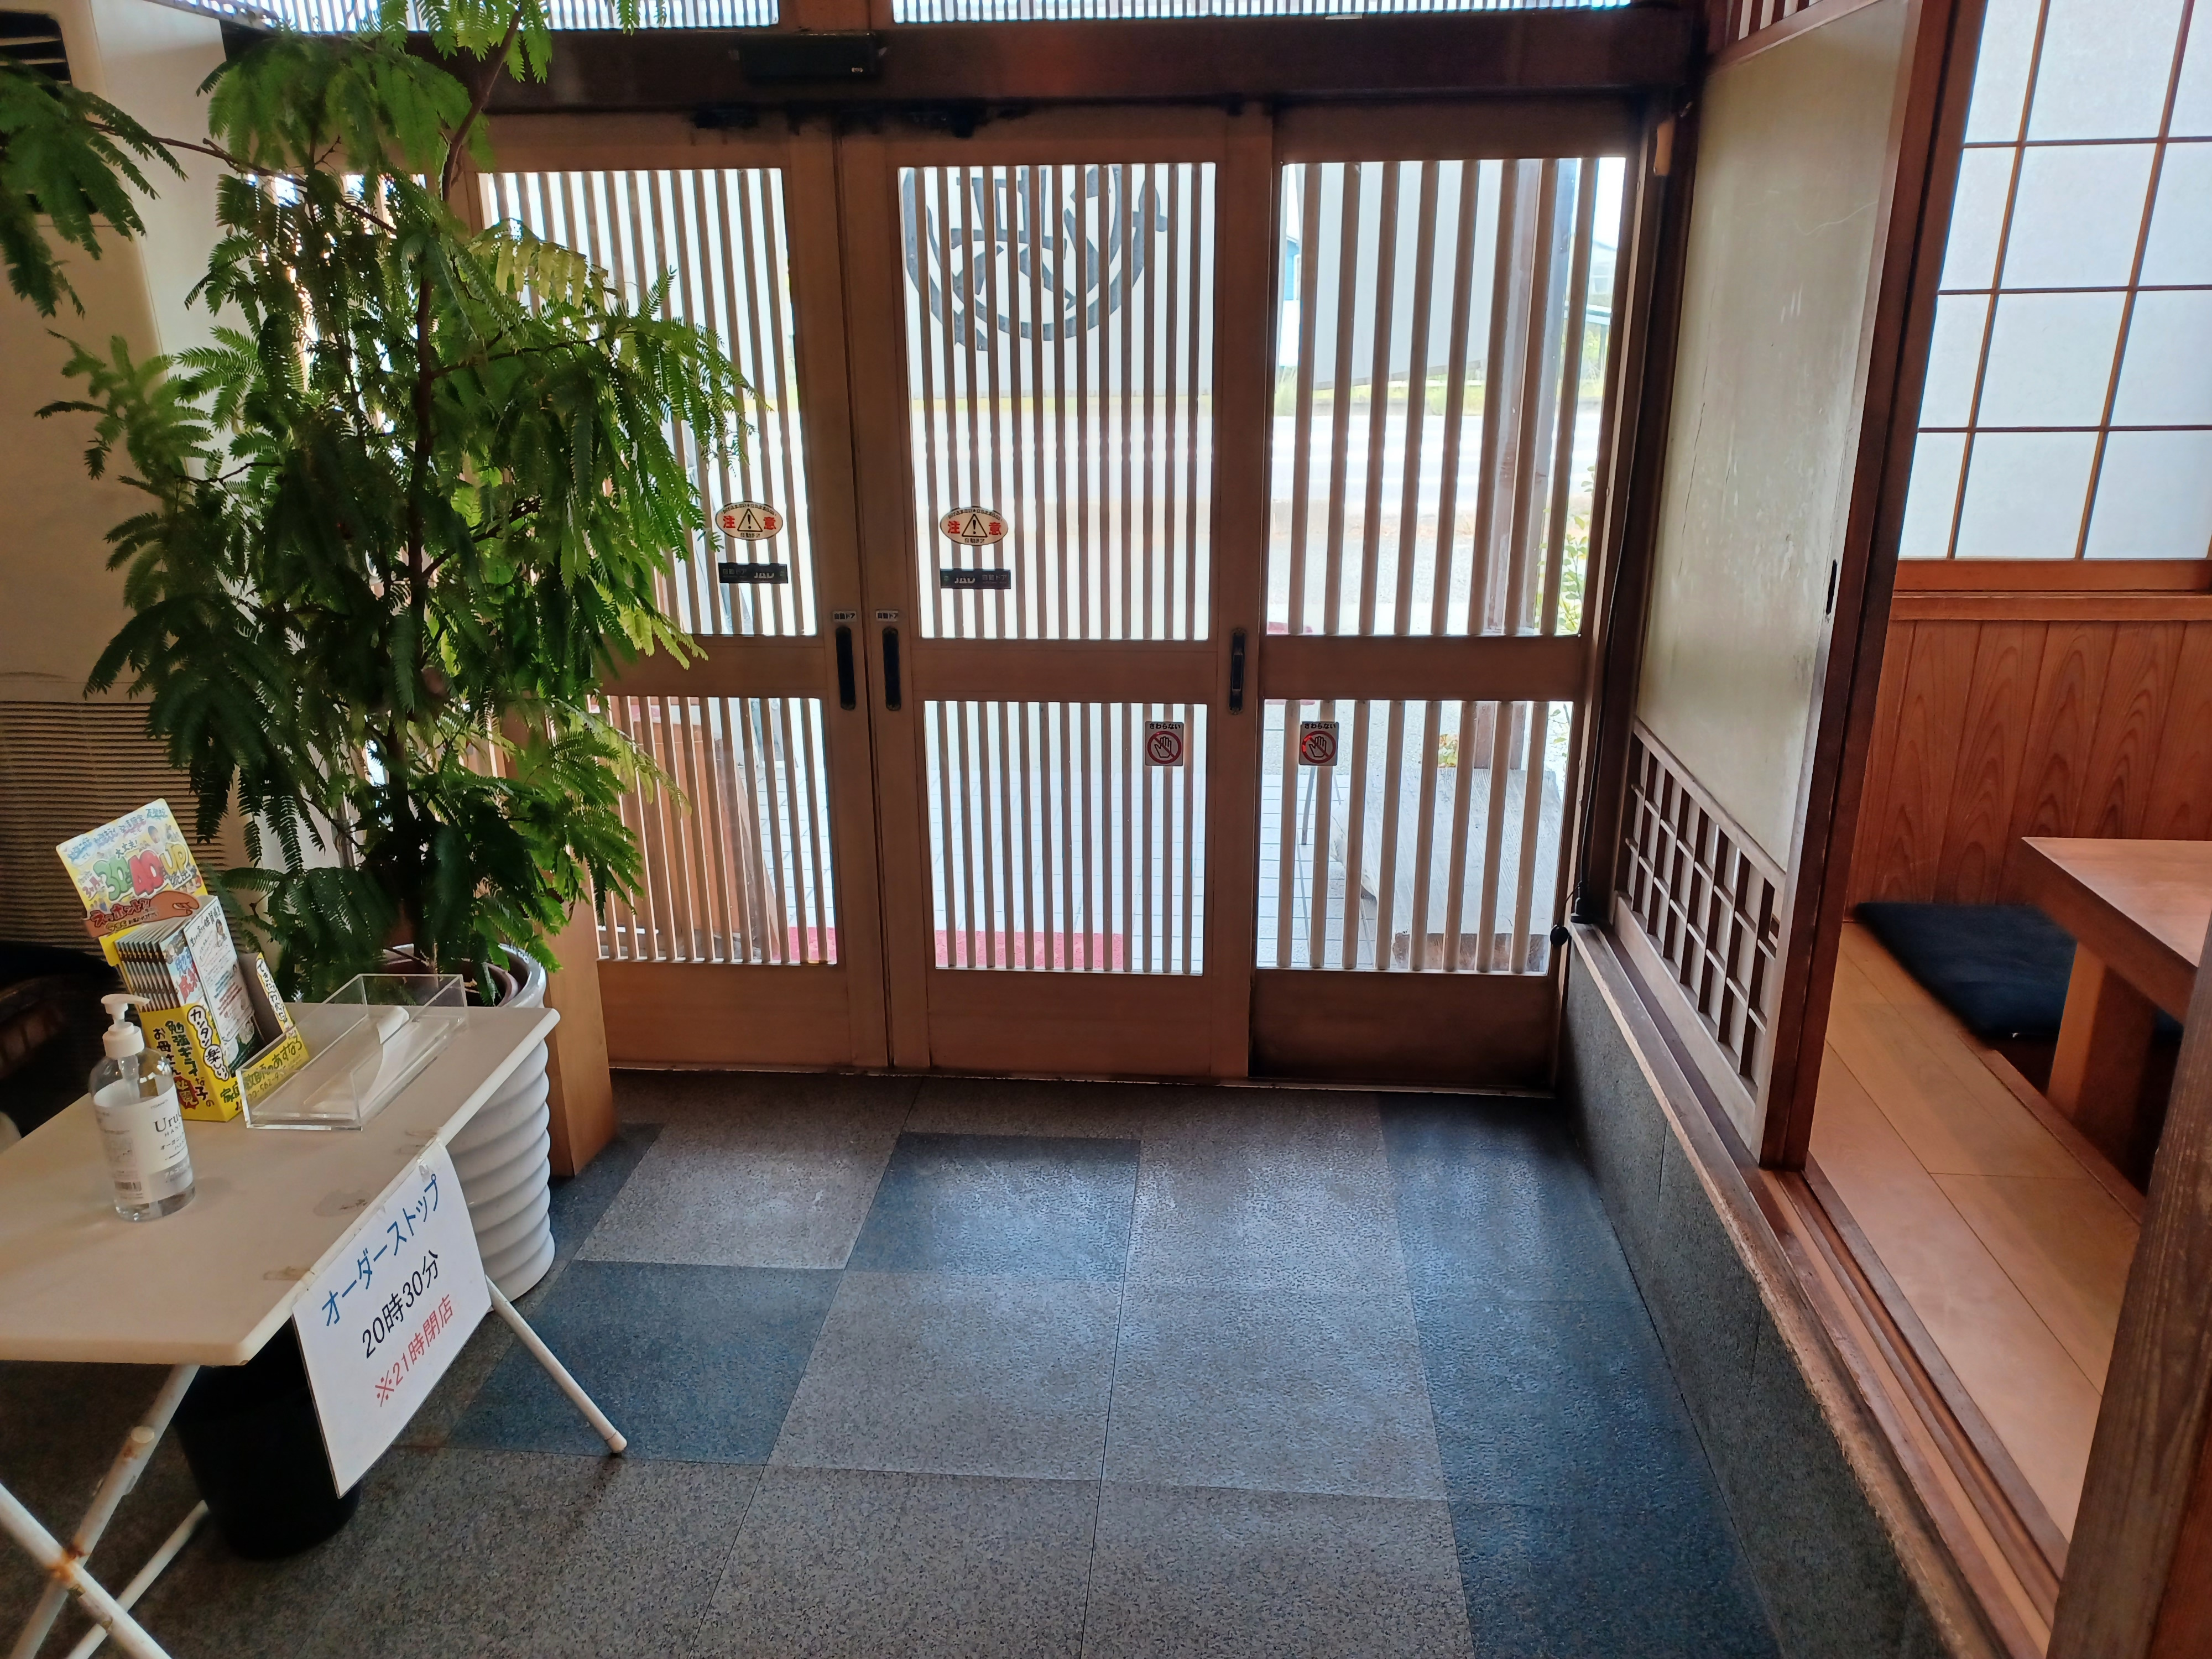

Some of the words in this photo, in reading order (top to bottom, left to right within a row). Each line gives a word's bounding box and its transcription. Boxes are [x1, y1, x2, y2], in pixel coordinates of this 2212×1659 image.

[723, 515, 735, 528] 注
[763, 517, 776, 530] 意
[947, 520, 961, 534] 注
[988, 522, 1002, 535] 意
[190, 1009, 210, 1047] カンタン
[322, 1173, 439, 1327] オーダーストップ
[362, 1249, 439, 1359] 20時30分
[374, 1294, 454, 1408] ※21時閉店
